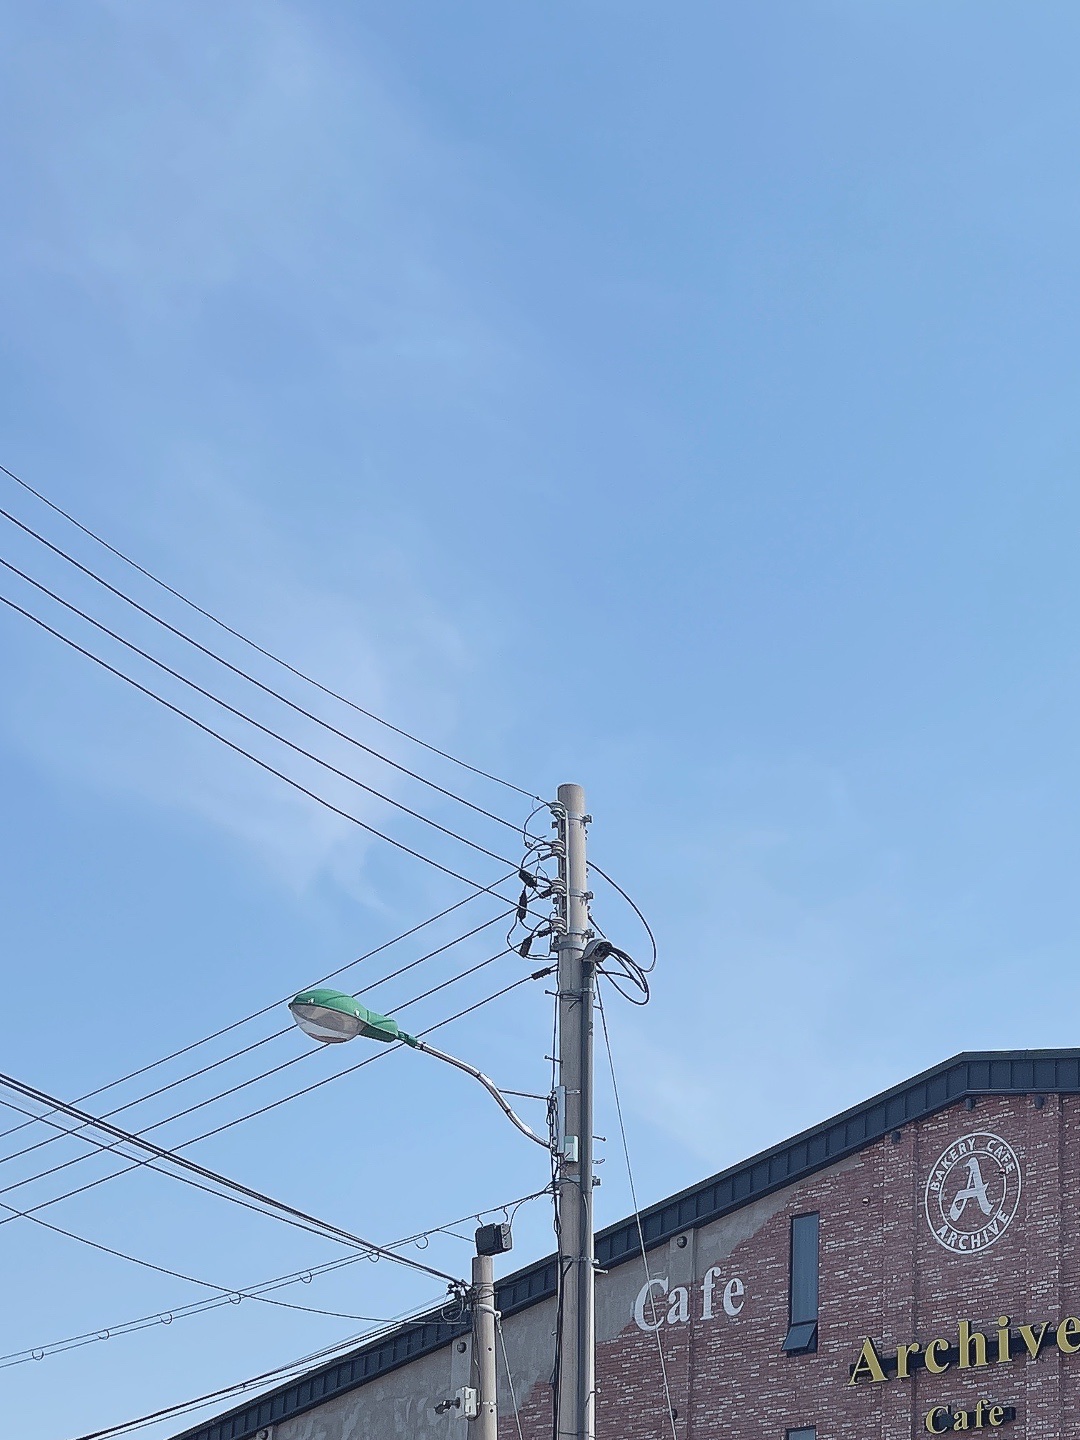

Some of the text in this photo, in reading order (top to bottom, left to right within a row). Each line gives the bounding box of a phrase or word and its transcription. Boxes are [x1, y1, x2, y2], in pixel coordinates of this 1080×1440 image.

[930, 1138, 1016, 1192] BAKERY CAFE
[949, 1157, 994, 1222] A
[936, 1210, 1010, 1250] ARCHIVE
[633, 1266, 745, 1332] Cafe
[925, 1398, 1005, 1435] Cafe
